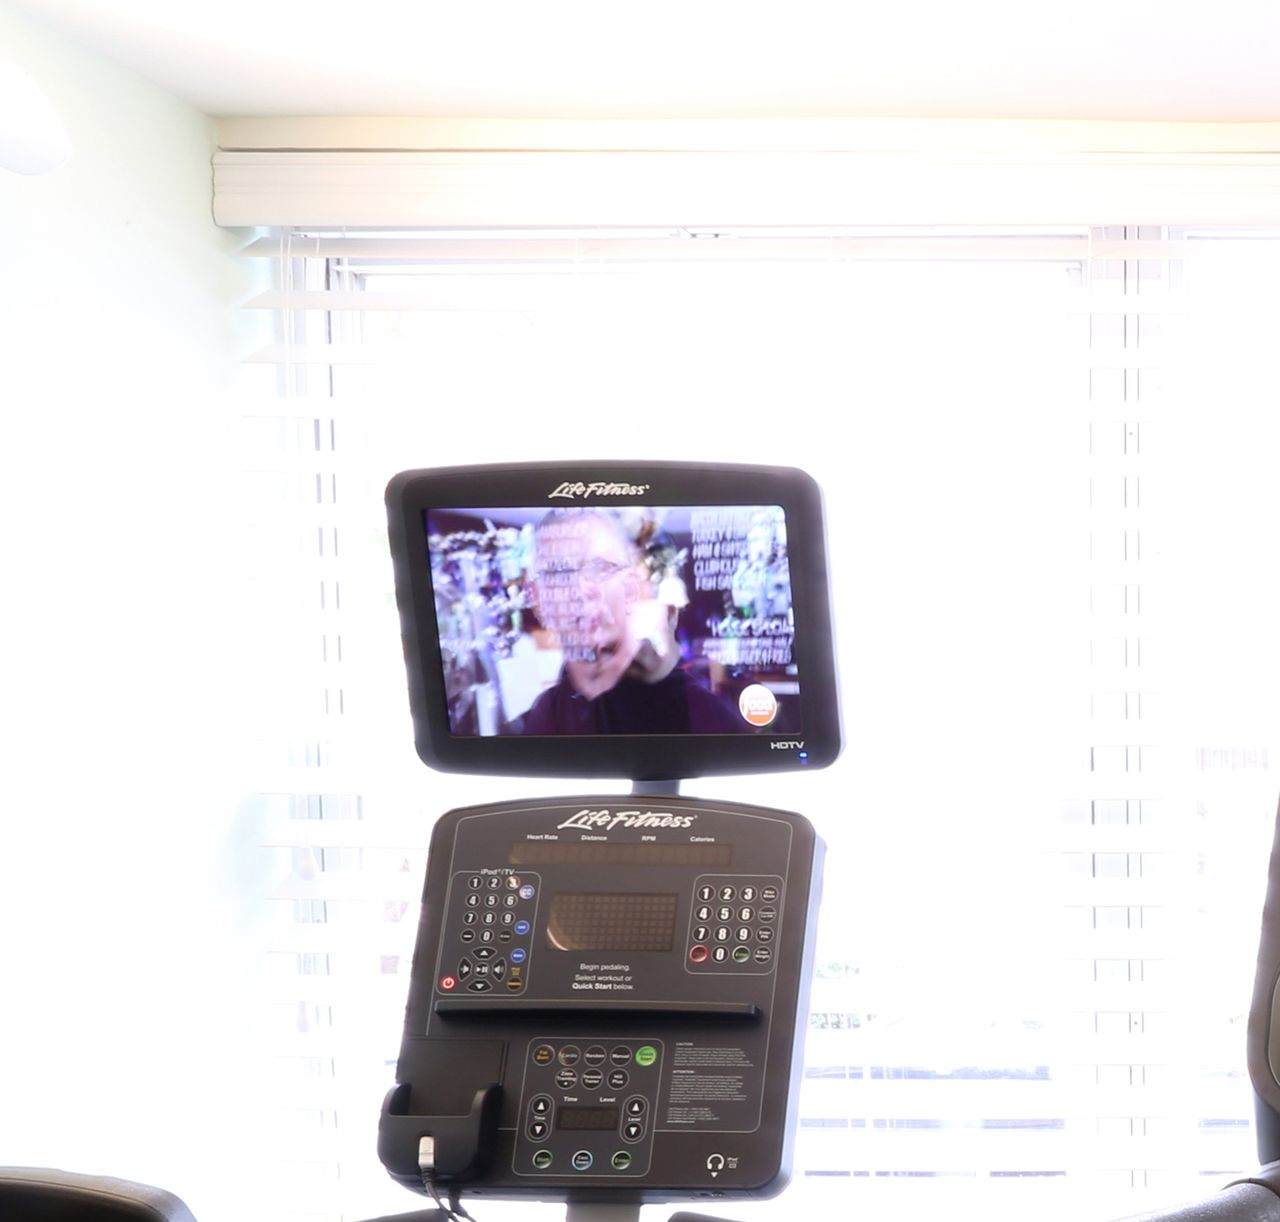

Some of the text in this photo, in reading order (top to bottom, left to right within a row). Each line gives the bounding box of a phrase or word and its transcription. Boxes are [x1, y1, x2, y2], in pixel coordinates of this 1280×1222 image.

[548, 482, 645, 498] Life Fitness
[770, 741, 804, 749] HDTV
[557, 809, 694, 831] Life Fitness
[580, 963, 599, 971] Begin
